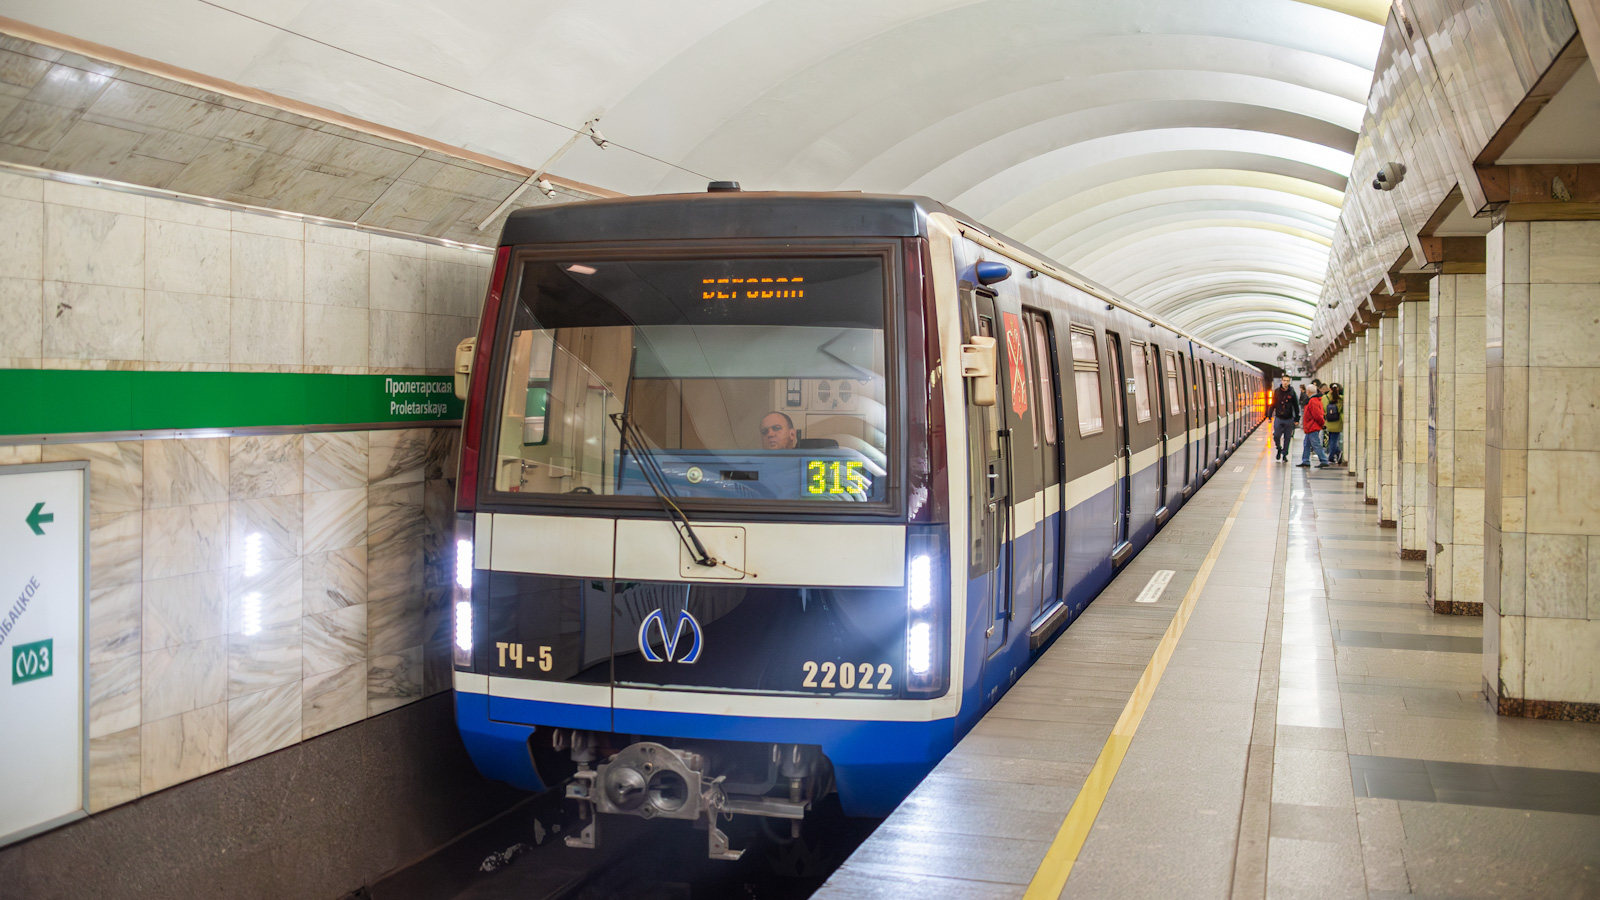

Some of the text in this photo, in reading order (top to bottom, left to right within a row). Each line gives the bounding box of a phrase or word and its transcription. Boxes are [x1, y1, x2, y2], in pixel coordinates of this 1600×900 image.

[385, 378, 453, 398] Пролетарская
[390, 400, 448, 418] Proletarskaya
[808, 461, 864, 494] 315
[496, 641, 553, 672] ТЧ-5
[802, 660, 893, 690] 22022
